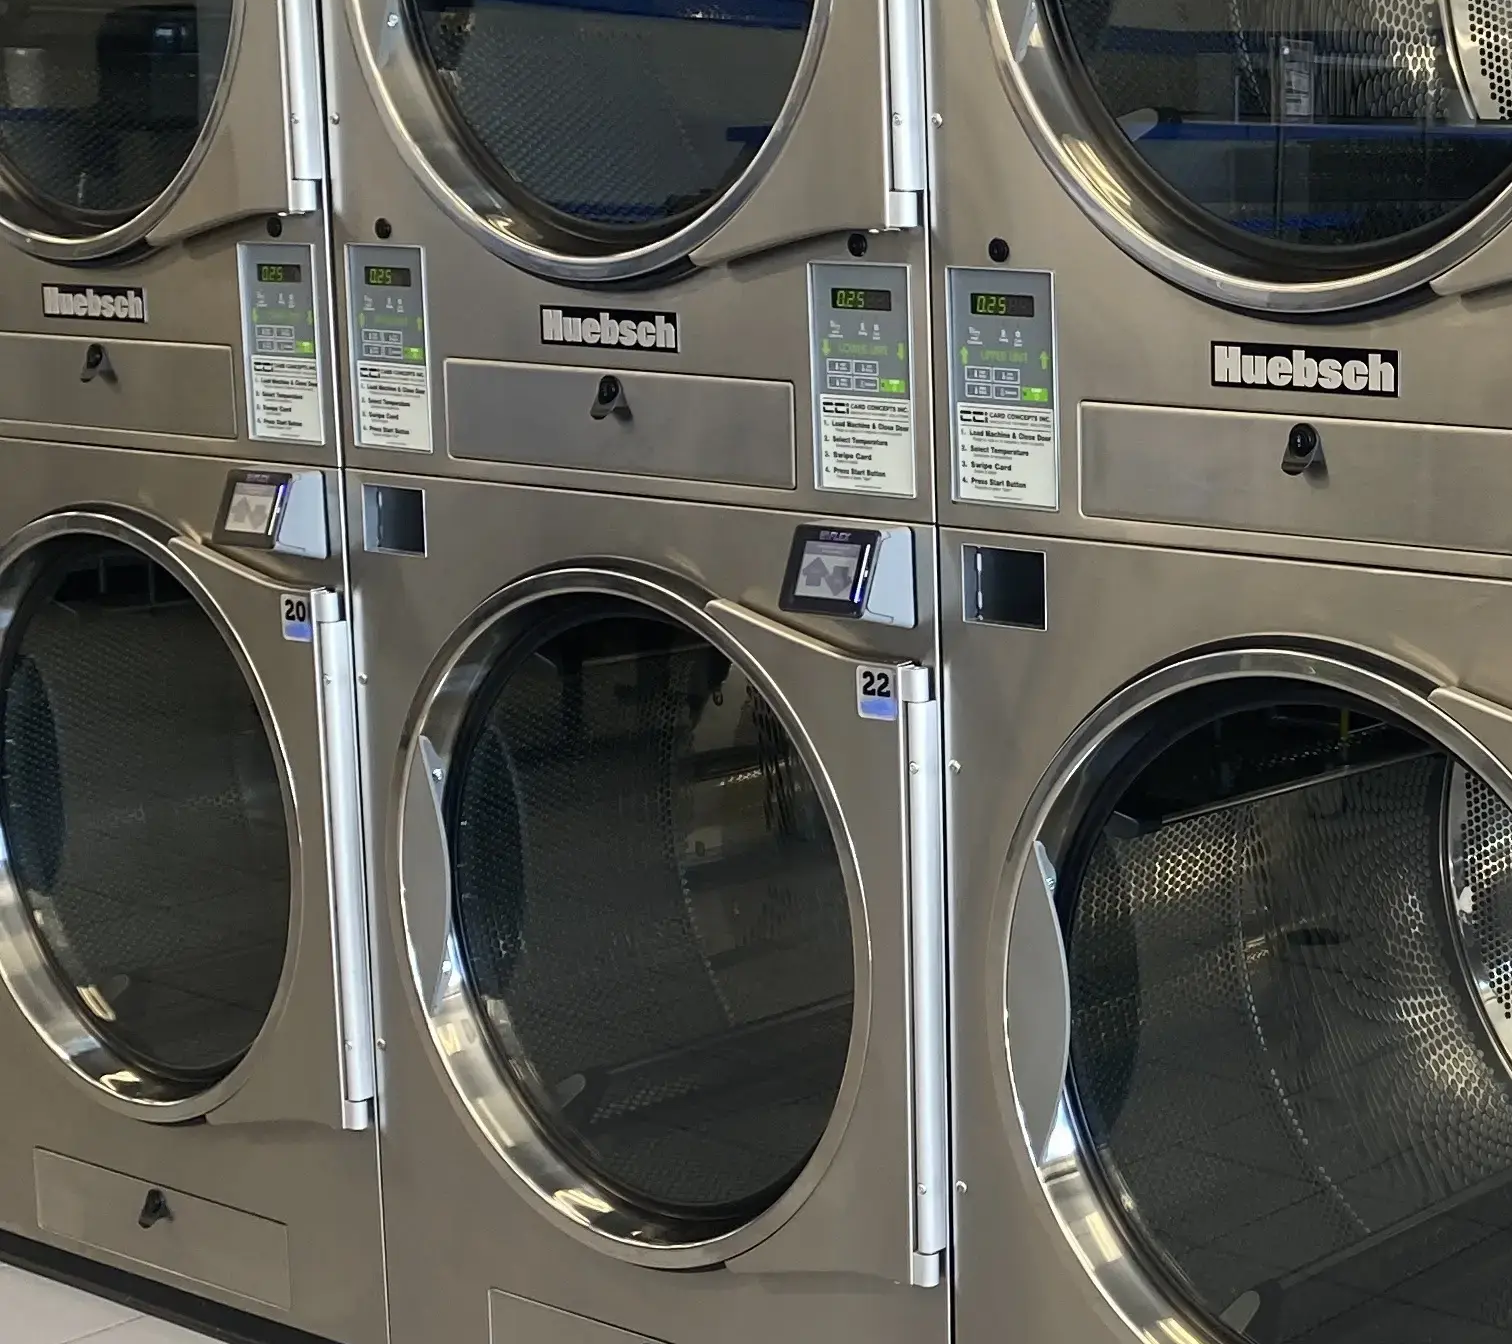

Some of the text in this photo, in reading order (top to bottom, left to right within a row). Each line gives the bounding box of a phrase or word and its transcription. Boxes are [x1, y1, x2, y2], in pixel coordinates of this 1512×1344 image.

[43, 286, 143, 319] Huebsch
[542, 309, 676, 348] Huebsch
[1214, 345, 1395, 392] Huebsch
[285, 599, 306, 622] 20
[862, 670, 890, 697] 22
